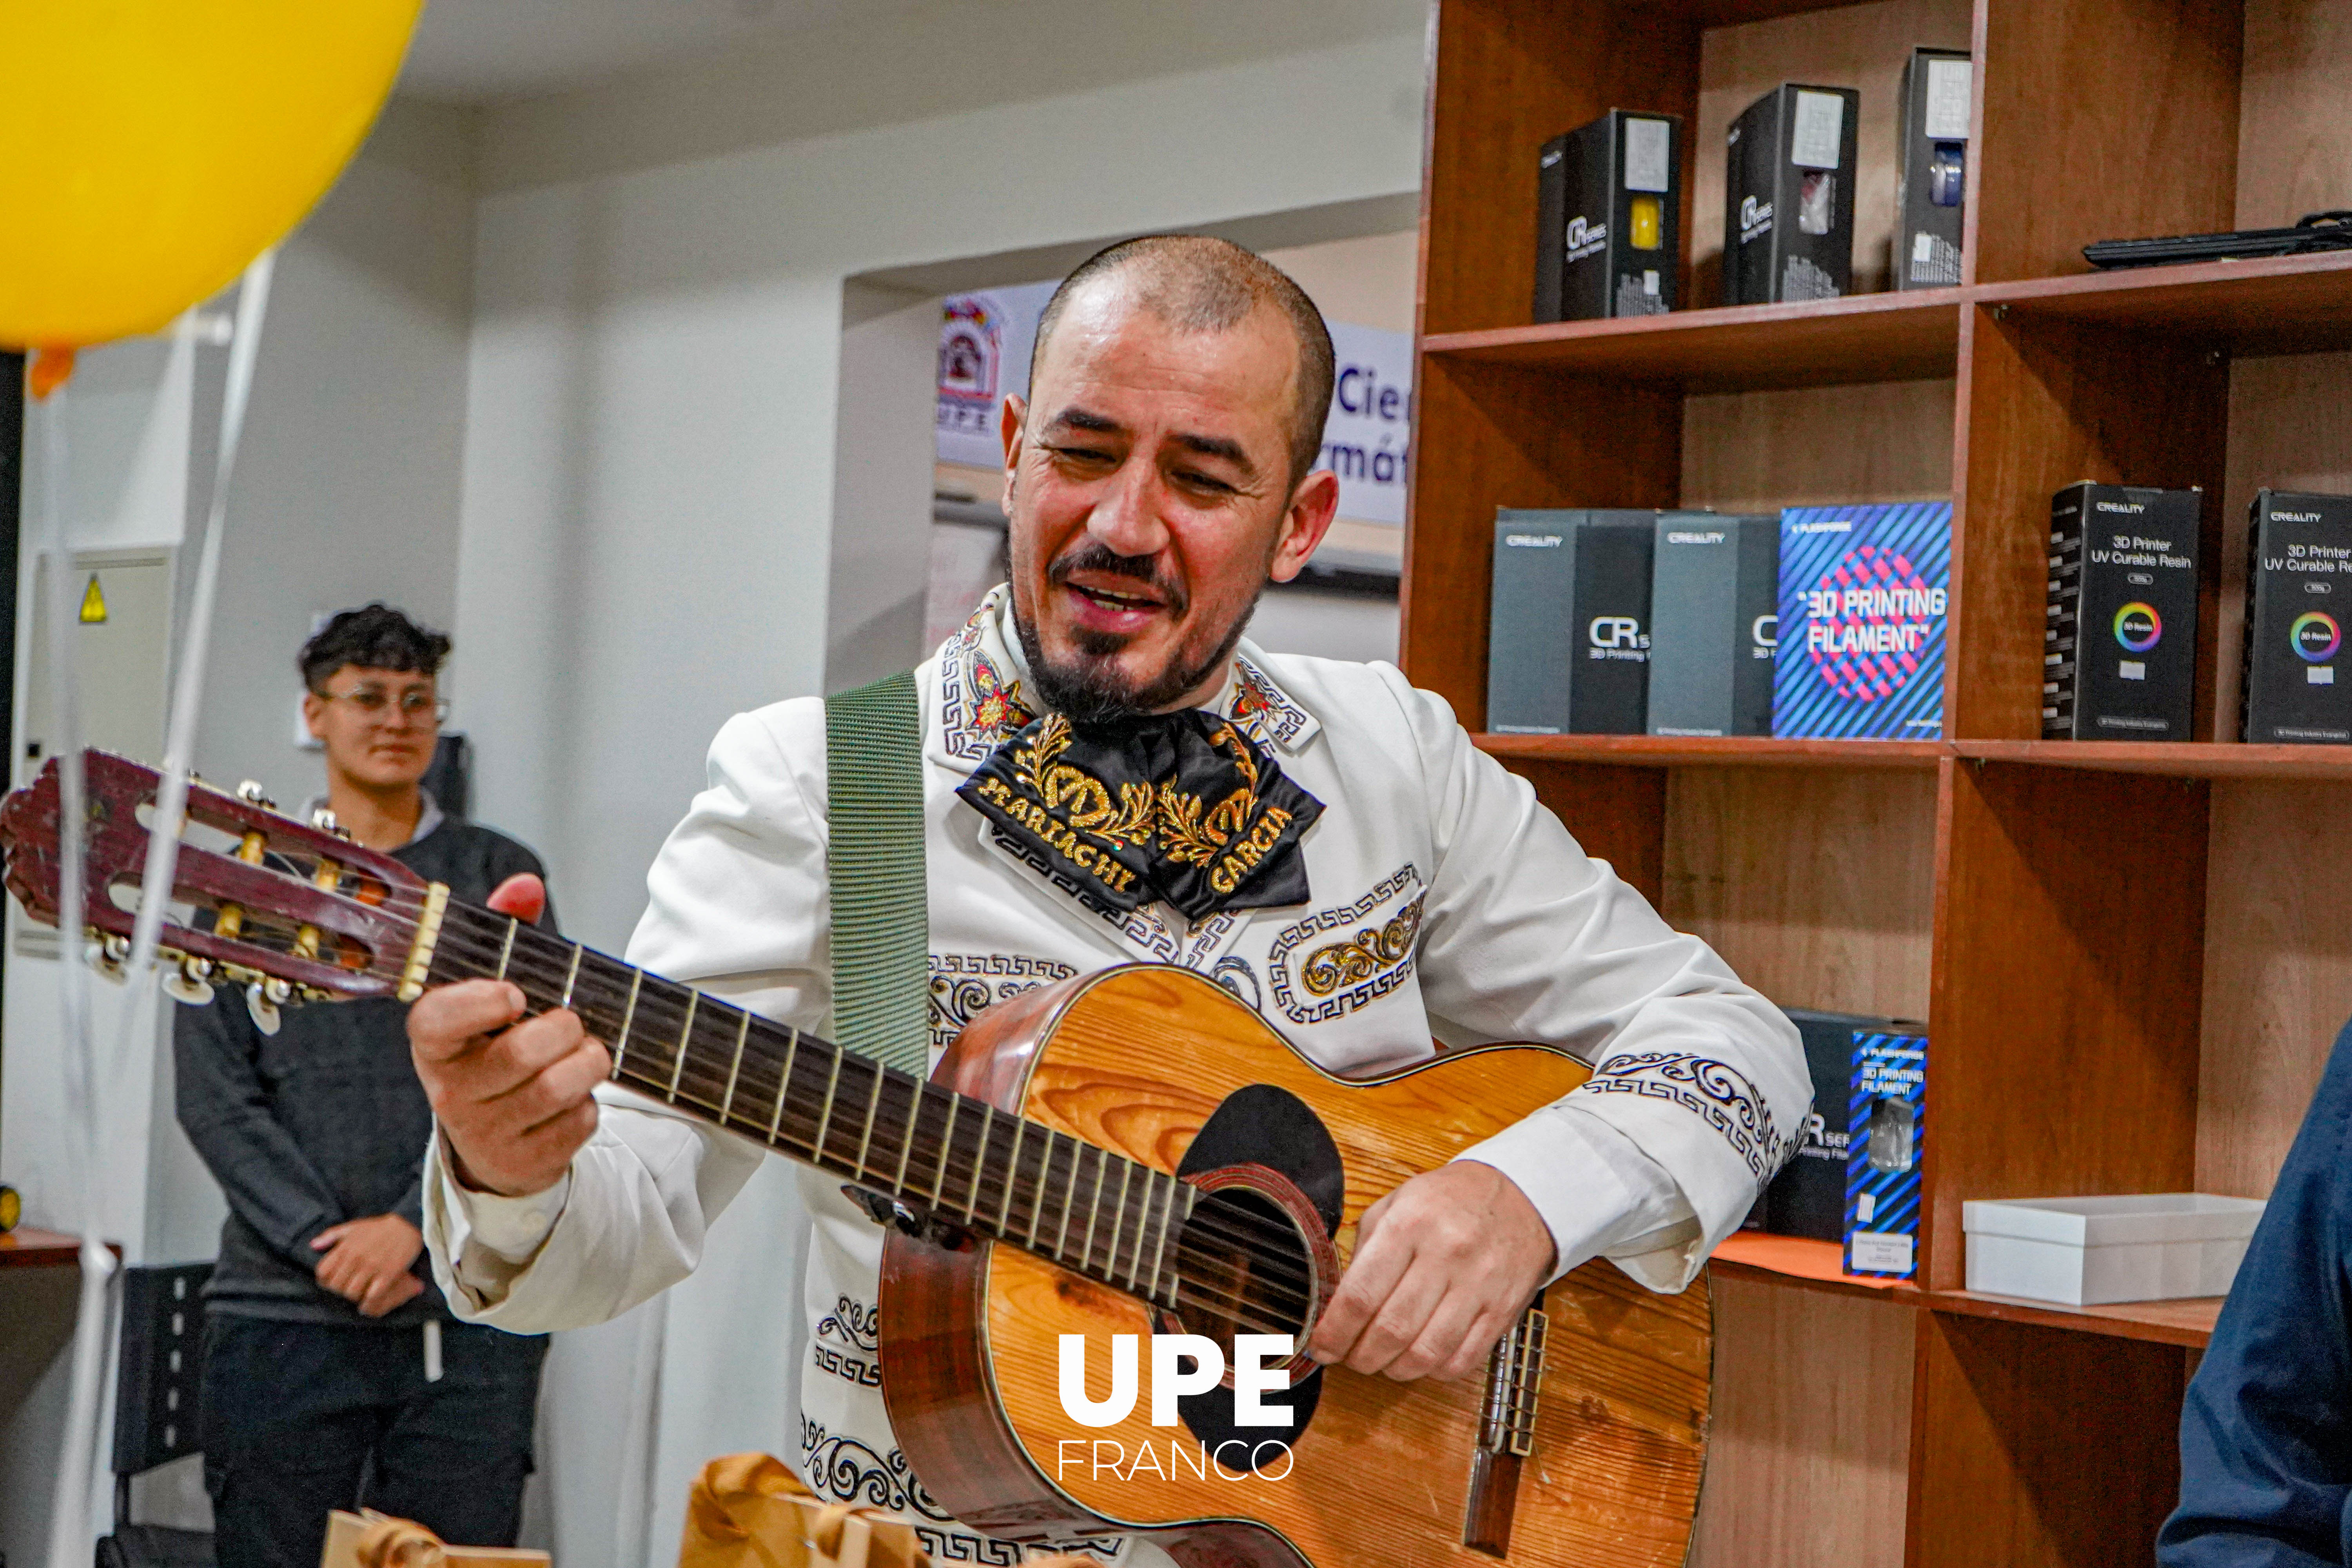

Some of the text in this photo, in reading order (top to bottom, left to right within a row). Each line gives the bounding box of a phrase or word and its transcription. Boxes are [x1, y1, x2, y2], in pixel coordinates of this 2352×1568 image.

[2097, 502, 2145, 514] CREALITY
[2270, 512, 2321, 523] CREALITY
[1506, 535, 1563, 547] CREALITY
[1667, 532, 1724, 544] CREALITY
[2114, 535, 2172, 552] 3D Printer
[2288, 544, 2352, 559] 3D Printer
[2091, 550, 2191, 569] UV Curable Resin
[2265, 558, 2283, 570] UV
[2287, 558, 2335, 572] Curable
[1844, 588, 1947, 617] PRINTING
[1752, 615, 1779, 646] C
[2311, 632, 2332, 641] Resin
[1590, 647, 1645, 662] 3D Printing
[1753, 647, 1769, 659] 3D
[978, 777, 1136, 892] MARIACHY
[1862, 1066, 1924, 1083] 3D PRINTING
[1862, 1080, 1911, 1095] FILAMENT
[1809, 1113, 1825, 1146] R
